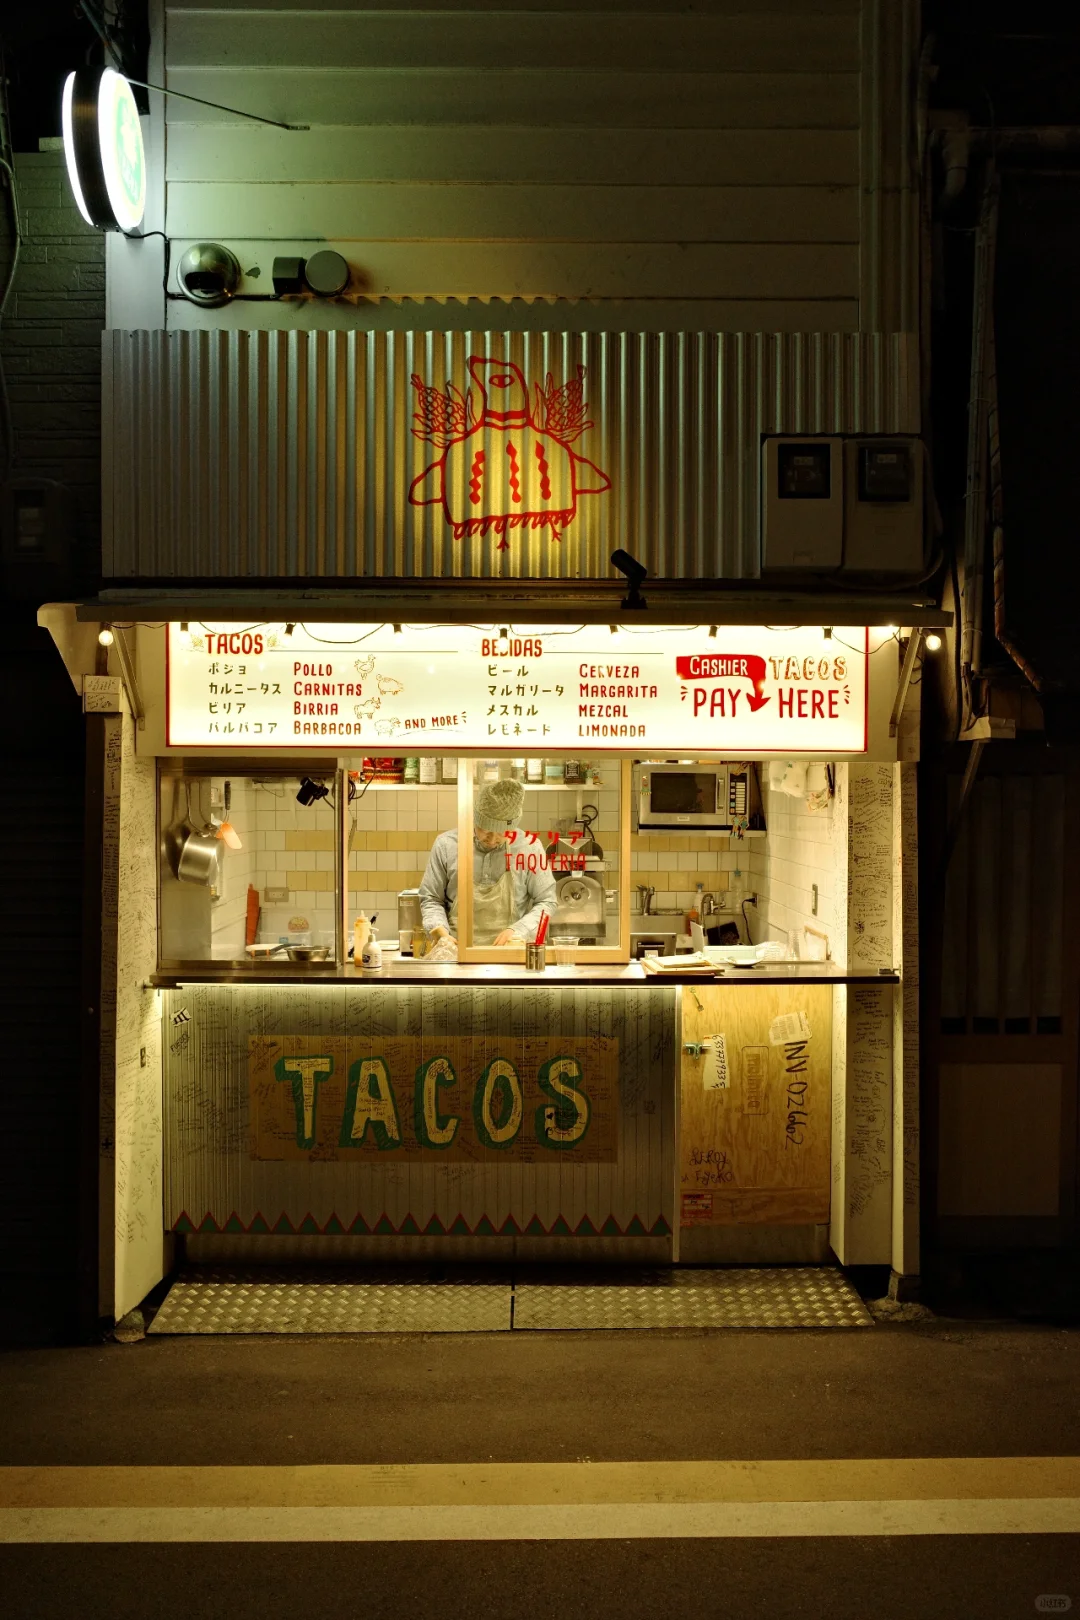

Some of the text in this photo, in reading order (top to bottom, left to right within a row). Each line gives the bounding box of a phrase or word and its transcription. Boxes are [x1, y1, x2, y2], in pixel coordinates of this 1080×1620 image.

[204, 633, 264, 655] TACOS
[208, 661, 247, 675] ポジョ
[293, 662, 333, 677] POLLO
[487, 663, 529, 677] ビール
[578, 663, 641, 679] CERVEZA
[689, 656, 749, 676] CASHIER
[768, 655, 848, 681] TACOS
[208, 681, 282, 695] カルニータス
[293, 681, 363, 697] CARNITAS
[487, 683, 565, 697] マルガリータ
[578, 682, 658, 699] MARGARITA
[208, 701, 247, 715] ビリア
[293, 701, 339, 716] BIRRIA
[486, 703, 539, 717] メスカル
[578, 703, 629, 718] MEZCAL
[693, 687, 840, 719] PAY HERE
[208, 721, 278, 734] バルバコア
[293, 721, 363, 736] BARBACOA
[404, 714, 460, 730] AND MORE
[578, 723, 647, 738] LIMONADA
[504, 830, 584, 846] タケリア
[504, 853, 587, 875] TAQUERIA
[274, 1054, 592, 1151] TACOS
